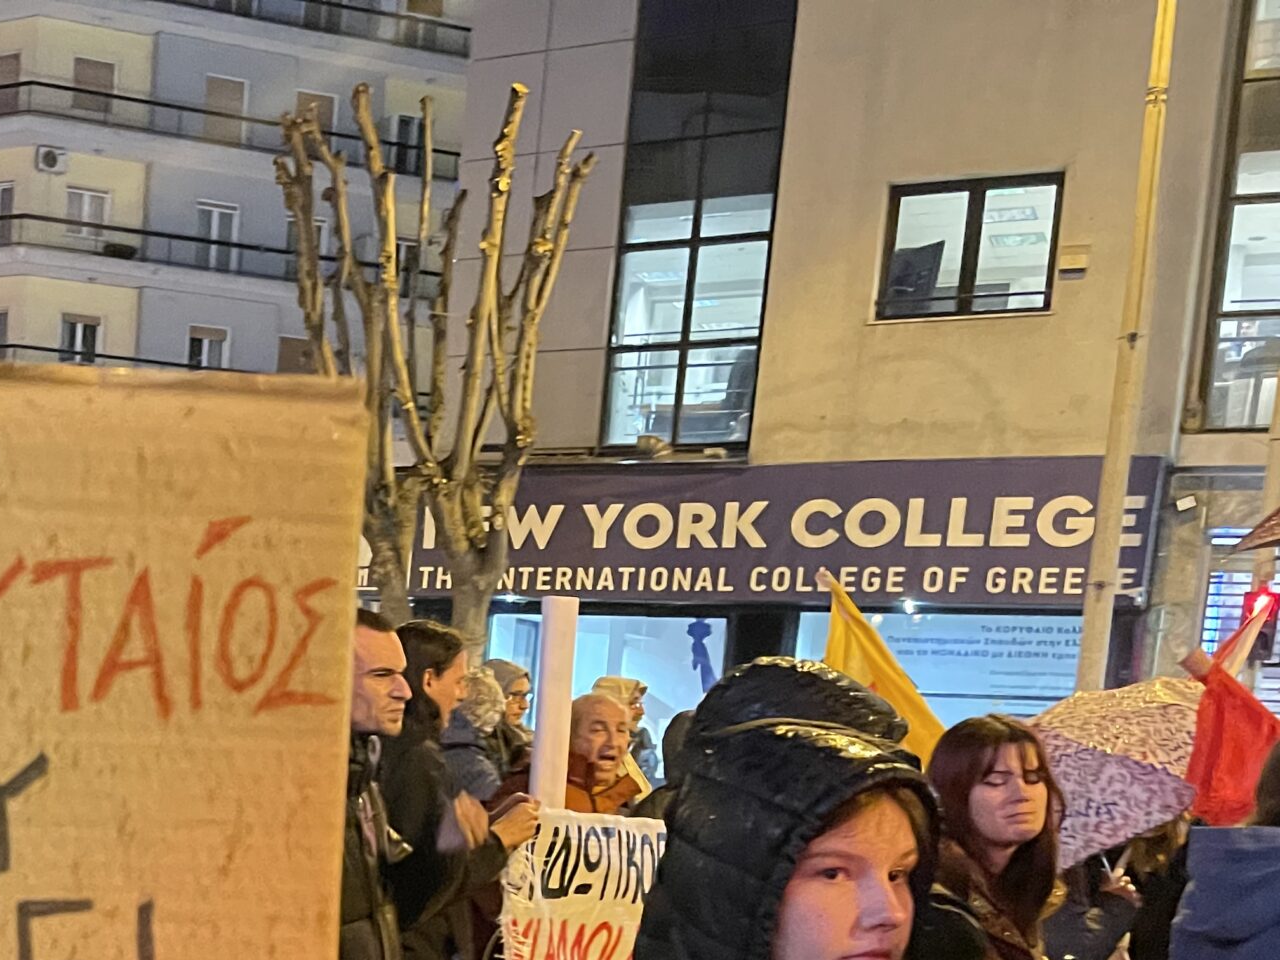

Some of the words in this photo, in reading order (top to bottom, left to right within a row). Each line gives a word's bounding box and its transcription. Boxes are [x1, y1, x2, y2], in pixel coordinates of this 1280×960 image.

[582, 500, 769, 550] YORK
[791, 494, 1147, 548] COLLEGE
[419, 566, 452, 590] TH
[497, 566, 734, 592] NTERNATIONAL
[923, 566, 969, 593] OF
[985, 566, 1137, 596] GREEE
